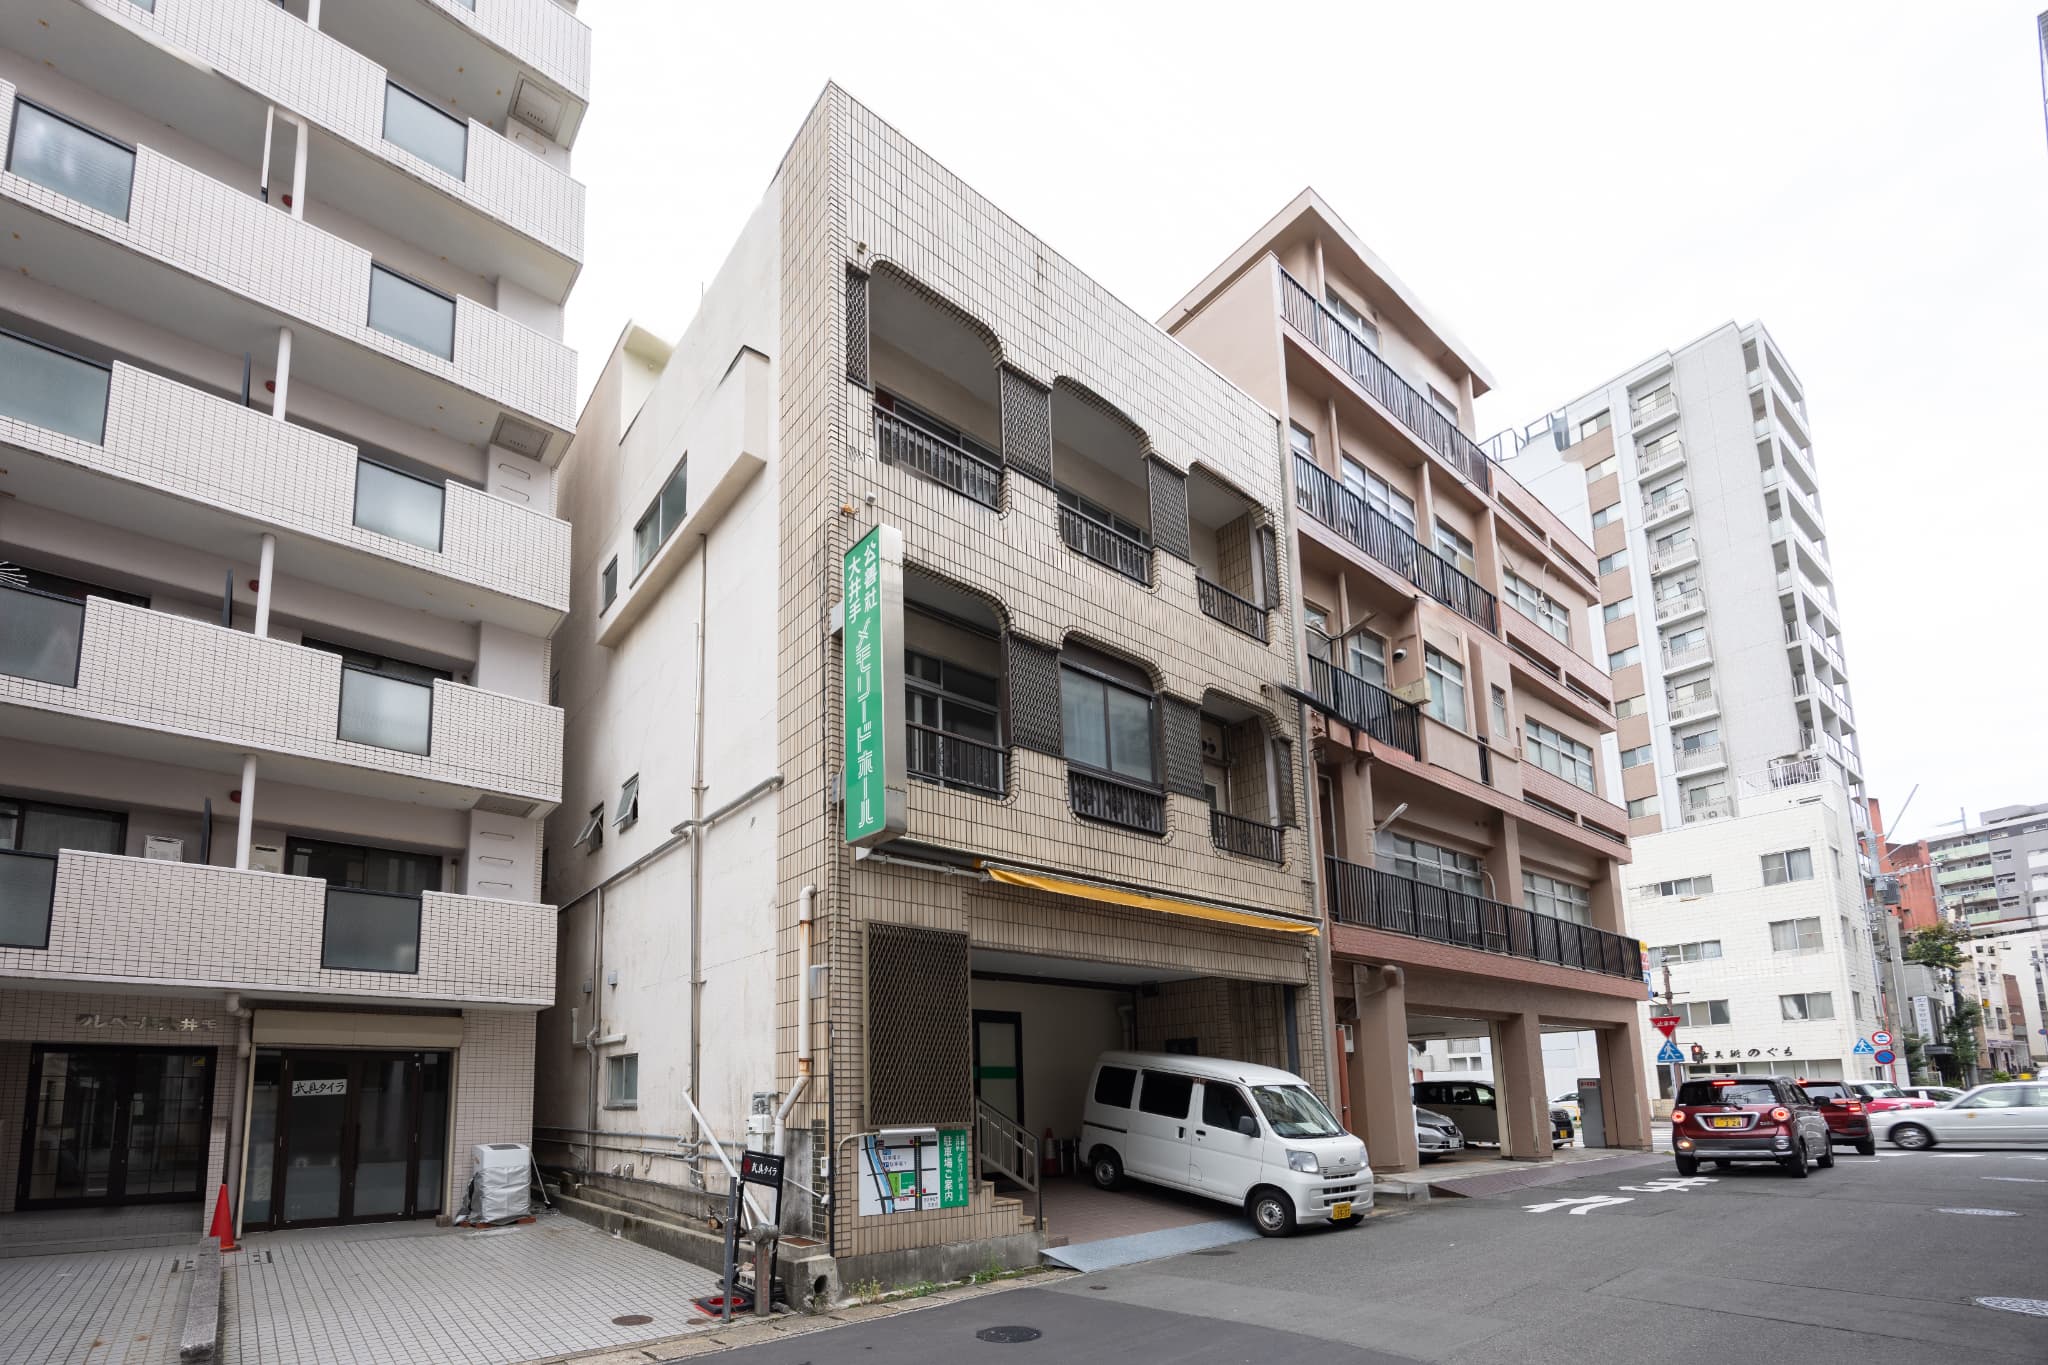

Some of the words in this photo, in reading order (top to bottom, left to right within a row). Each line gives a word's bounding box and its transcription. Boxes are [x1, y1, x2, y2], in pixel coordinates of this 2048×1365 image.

[848, 556, 861, 624] 大井手
[864, 540, 878, 613] 公善社
[855, 617, 874, 829] メモリードホール
[943, 1135, 953, 1202] 駐車場ご案内
